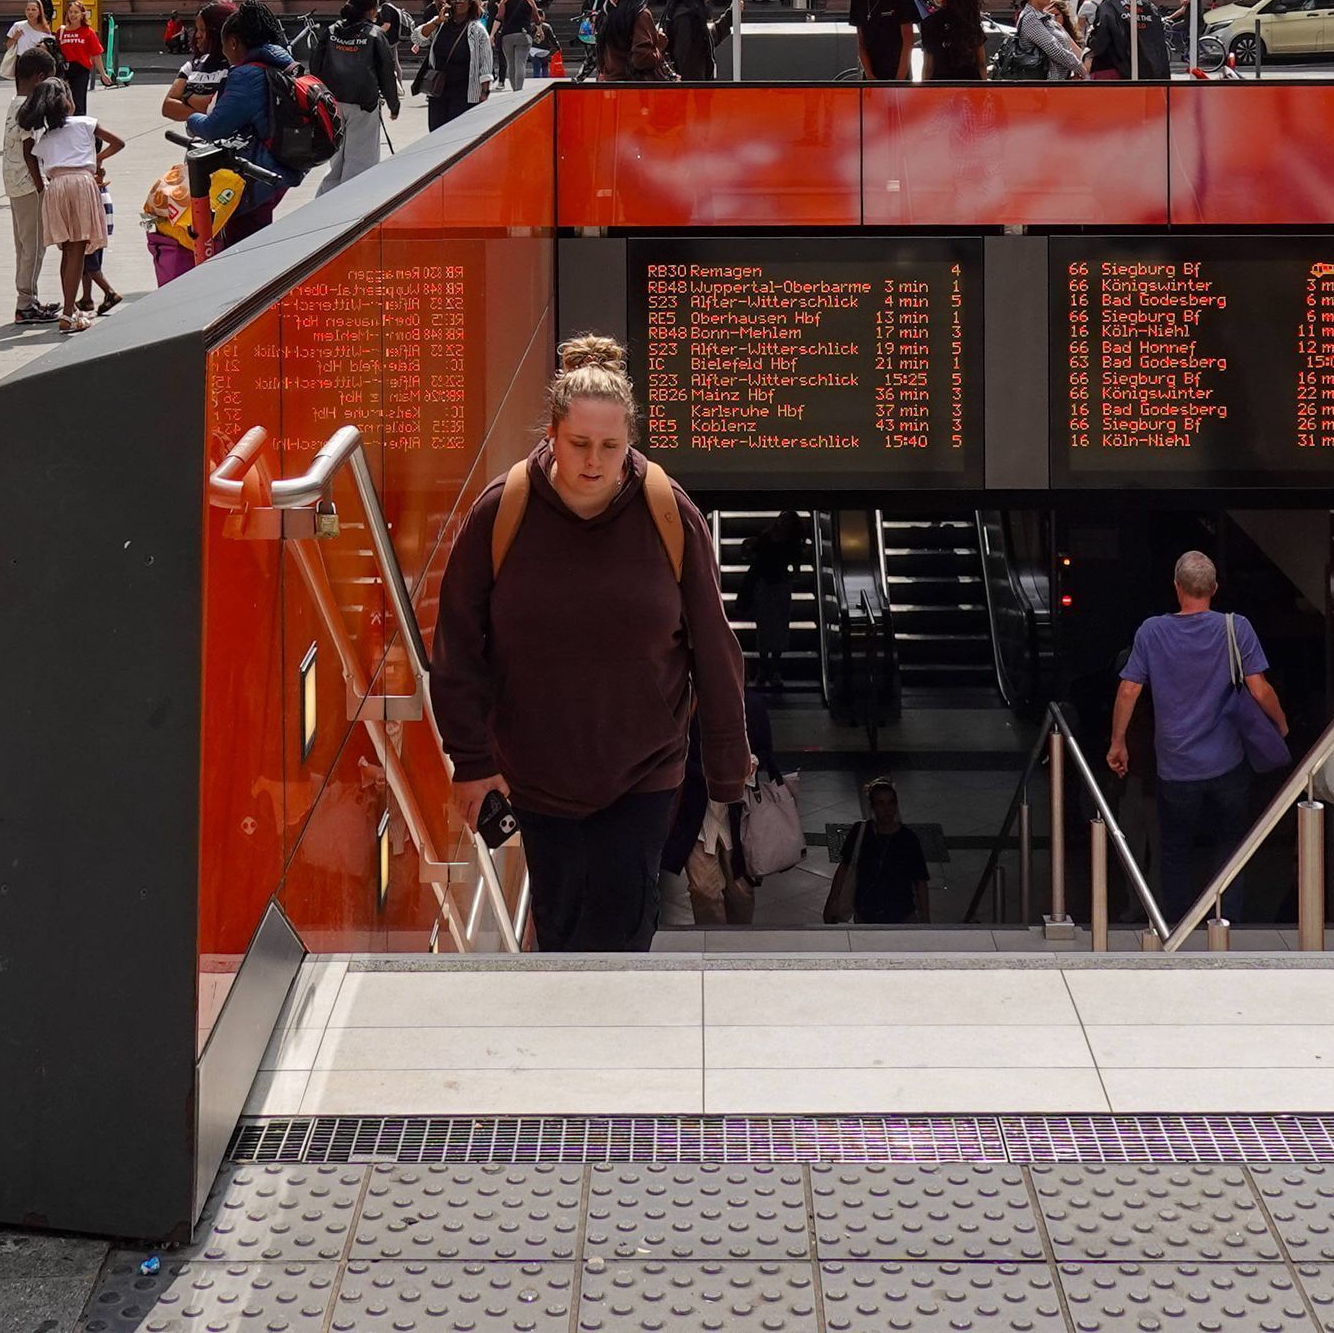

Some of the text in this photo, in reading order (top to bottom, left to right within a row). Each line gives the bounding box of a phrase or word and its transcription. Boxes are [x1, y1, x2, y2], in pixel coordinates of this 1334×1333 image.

[648, 264, 961, 281] RB30 Remagen 4
[1069, 263, 1089, 275] 66
[1102, 263, 1175, 278] Siegburg
[1183, 263, 1201, 278] Bf
[648, 280, 960, 297] RB48 Wuppertal-Oberbarme 3 min 1
[1069, 279, 1089, 291] 66
[1102, 279, 1212, 294] Königswinter
[1307, 278, 1317, 291] 3
[648, 295, 961, 312] S23 Alfter-Witterschlick 4 min 5
[1070, 294, 1089, 306] 16
[1102, 294, 1132, 306] Bad
[1139, 294, 1227, 310] Godesberg
[1306, 293, 1317, 306] 6
[648, 311, 960, 327] RE5 Oberhausen Hbf 13 min 1
[1069, 311, 1089, 323] 66
[1102, 311, 1175, 326] Siegburg
[1183, 311, 1202, 326] Bf
[1306, 310, 1317, 322] 6
[648, 326, 962, 339] RB48 Bonn-Mehlem 17 min 3
[1070, 325, 1089, 338] 16
[1102, 325, 1191, 338] Köln-Niehl
[1298, 324, 1316, 337] 11
[648, 342, 962, 358] S23 Alfter-Witterschlick 19 min 5
[1069, 341, 1089, 354] 66
[1102, 341, 1132, 354] Bad
[1139, 341, 1197, 357] Honnef
[1298, 340, 1317, 353] 12
[648, 357, 960, 374] IC Bielefeld Hbf 21 min 1
[1069, 356, 1090, 368] 63
[1102, 356, 1132, 368] Bad
[1139, 356, 1227, 371] Godesberg
[648, 373, 962, 390] S23 Alfter-Witterschlick 15:25 5
[1069, 372, 1089, 385] 66
[1102, 372, 1176, 388] Siegburg
[1183, 372, 1201, 388] Bf
[1299, 372, 1317, 384] 16
[648, 388, 962, 404] RB26 Mainz Hbf 36 min 3
[1069, 387, 1089, 400] 66
[1102, 387, 1213, 403] Königswinter
[1297, 386, 1317, 399] 22
[648, 404, 962, 421] IC Karlsruhe Hbf 37 min 3
